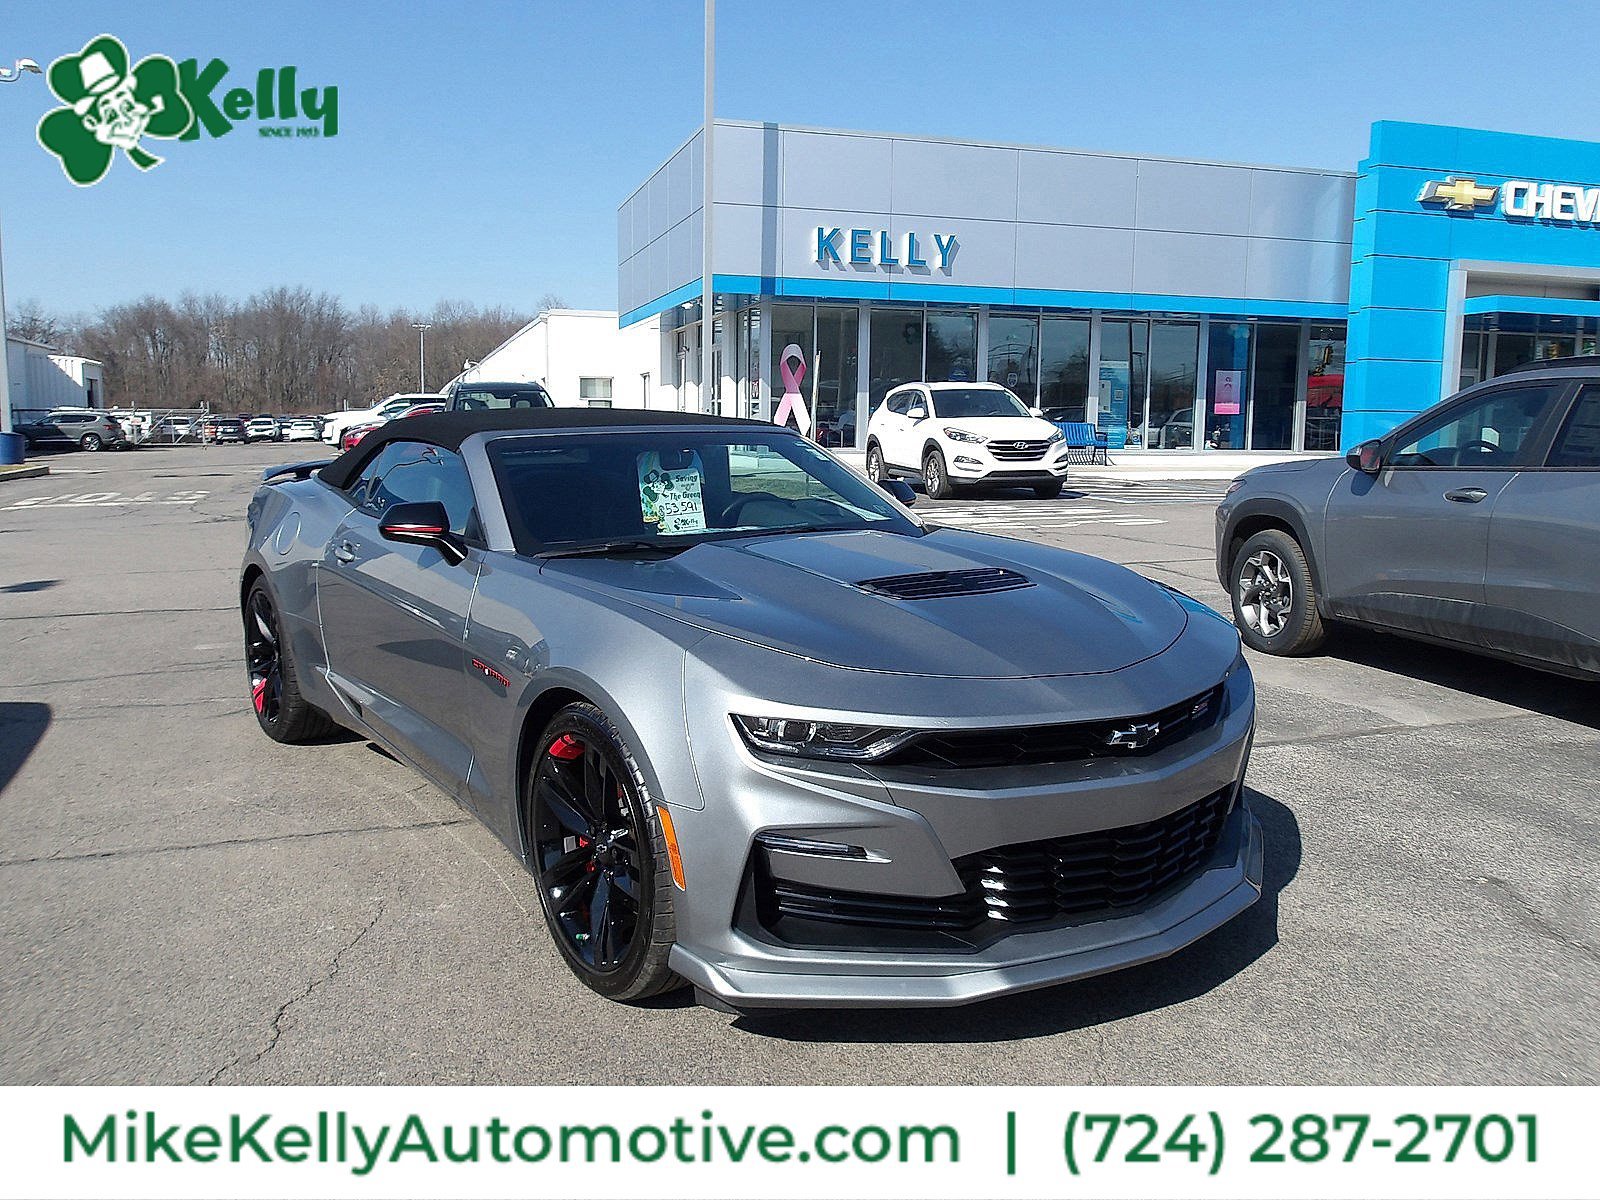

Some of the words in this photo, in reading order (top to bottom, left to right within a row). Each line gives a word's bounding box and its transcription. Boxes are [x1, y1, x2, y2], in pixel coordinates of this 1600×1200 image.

[1501, 180, 1600, 223] CHEV
[815, 226, 956, 268] KELLY
[669, 492, 682, 501] The
[682, 491, 701, 499] Green
